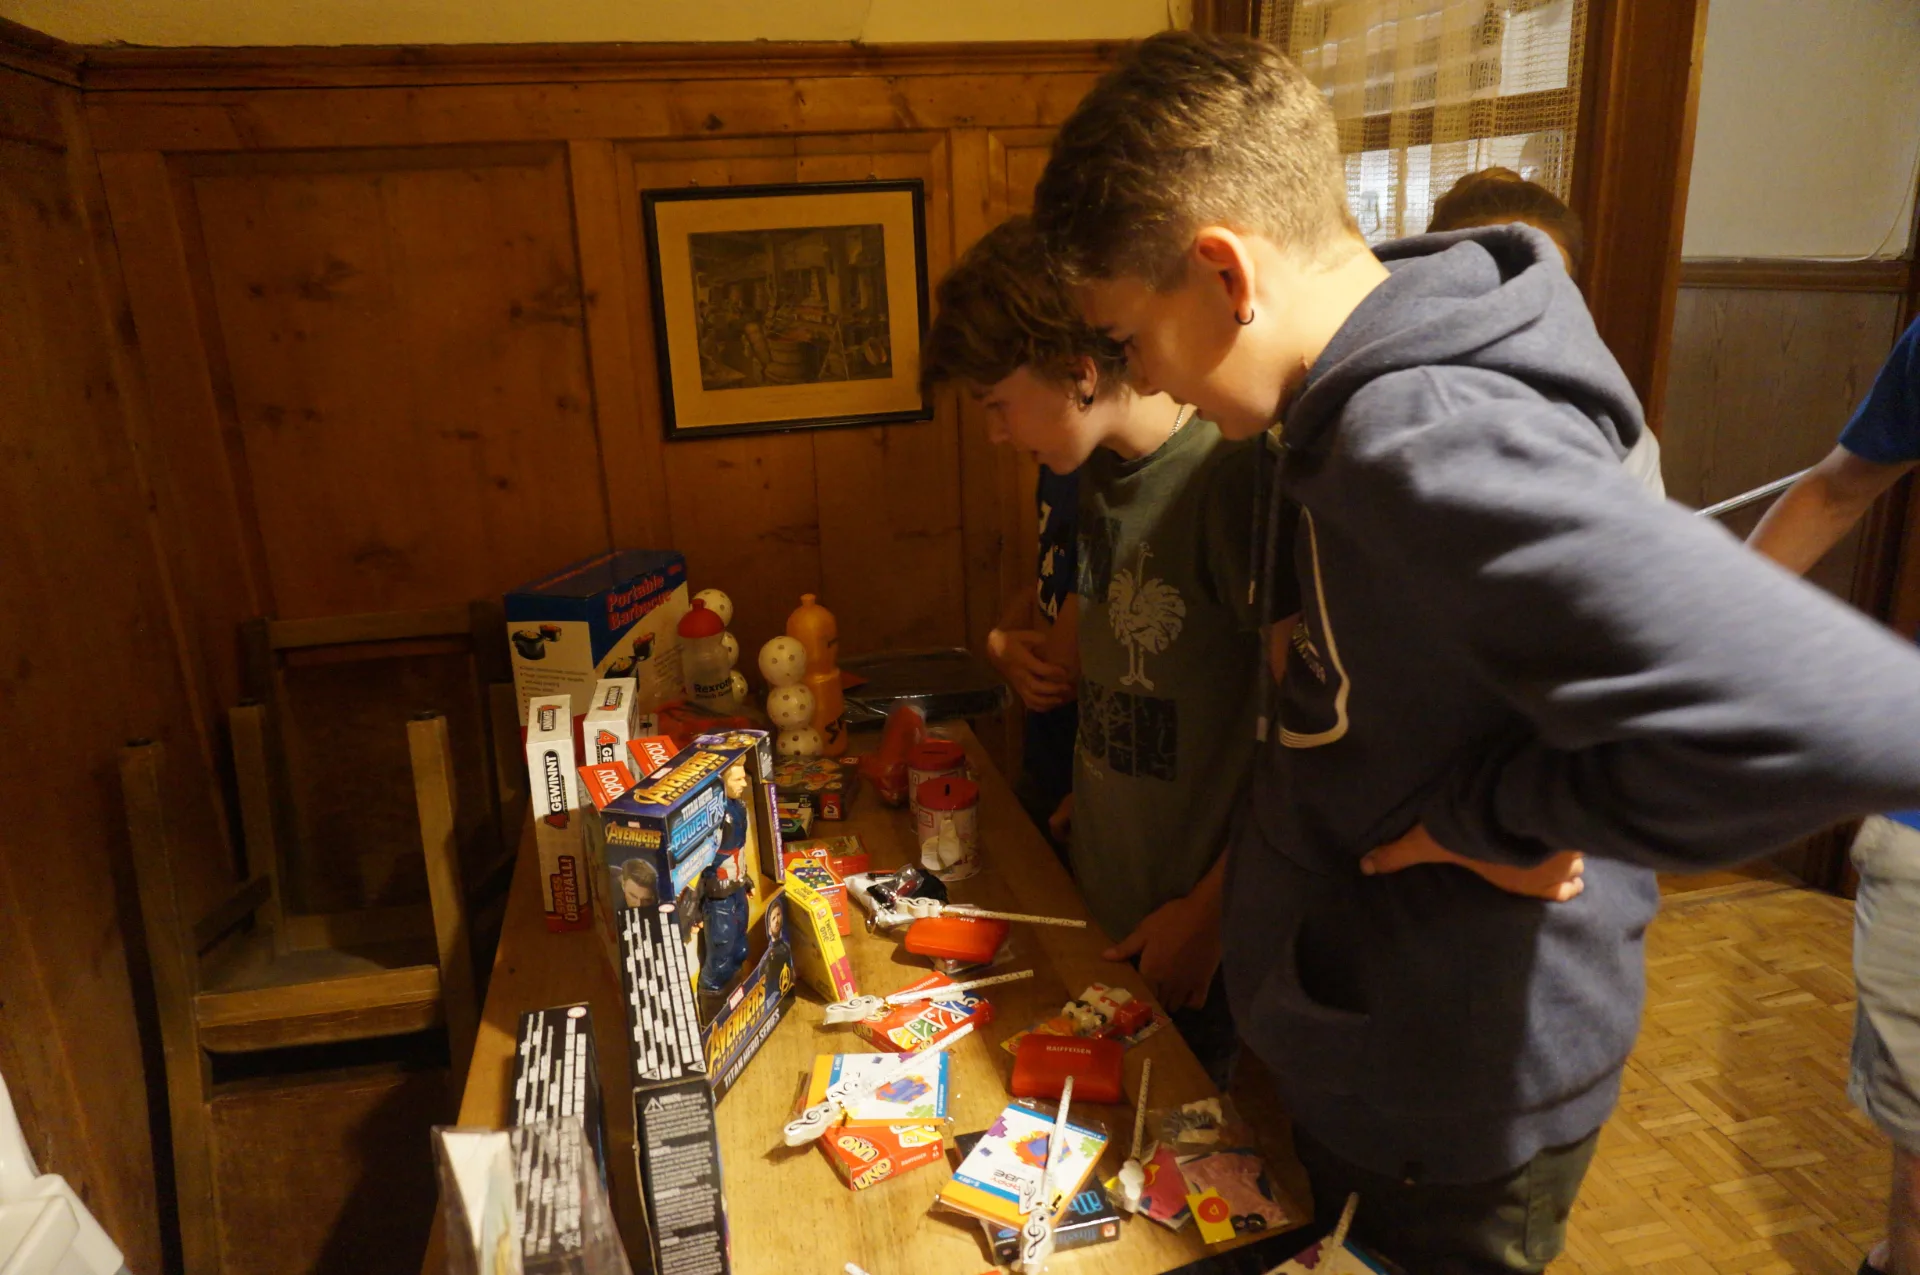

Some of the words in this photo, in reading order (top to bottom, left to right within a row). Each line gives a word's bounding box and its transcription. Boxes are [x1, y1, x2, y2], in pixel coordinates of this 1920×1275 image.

[607, 575, 664, 612] Portable
[607, 589, 676, 631] Barbecue
[545, 755, 563, 812] GEWINNT
[605, 821, 661, 845] AVENGERS
[673, 812, 708, 850] POWER
[563, 858, 579, 922] ÜBERALL!
[818, 925, 830, 943] one
[824, 918, 837, 943] twenty
[723, 1057, 744, 1090] TITAN
[742, 1037, 761, 1070] HERO
[758, 1007, 781, 1042] SERIES
[1046, 1045, 1092, 1055] RAIFFEISEN
[837, 1135, 880, 1163] UNO
[852, 1157, 892, 1191] UNO
